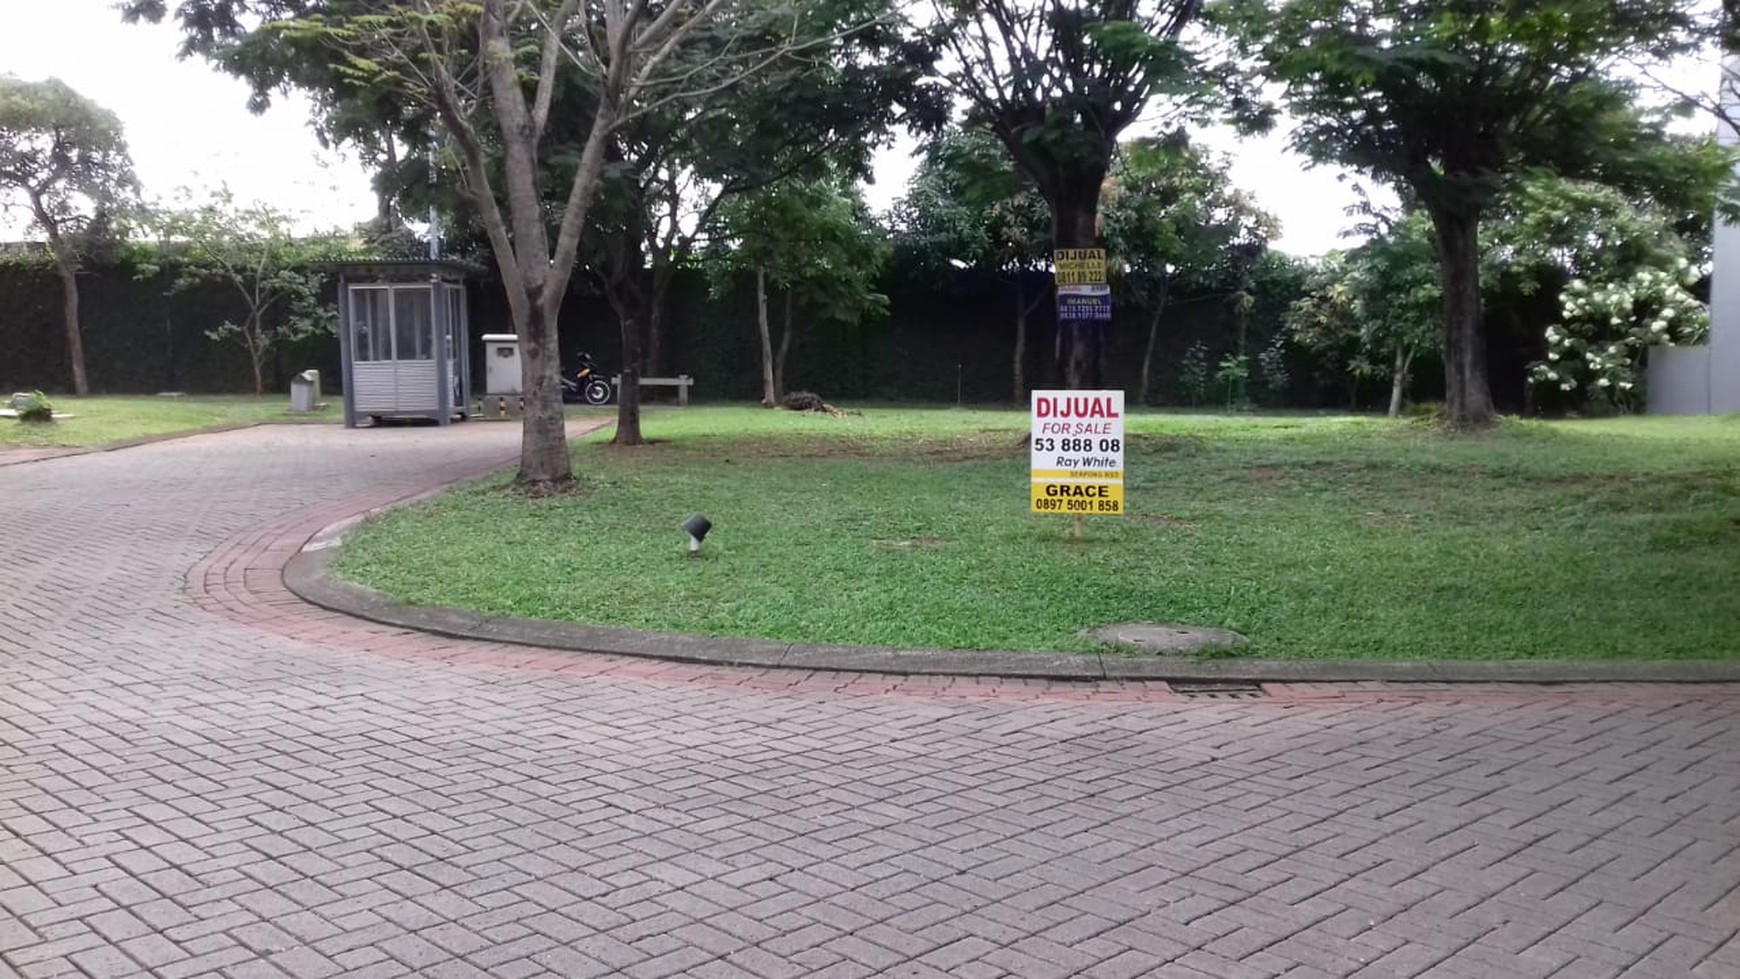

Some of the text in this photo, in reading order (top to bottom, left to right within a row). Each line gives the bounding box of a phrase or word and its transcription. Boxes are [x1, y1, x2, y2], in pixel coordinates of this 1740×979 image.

[1056, 250, 1104, 260] DIJUAL
[1089, 270, 1102, 282] 222
[1036, 397, 1119, 418] DIJUAL
[1042, 422, 1112, 435] FOR SALE
[1035, 438, 1120, 452] 53 888 08
[1056, 456, 1117, 468] Ray White
[1045, 484, 1109, 498] GRACE
[1036, 499, 1119, 511] 0897 5001 858
